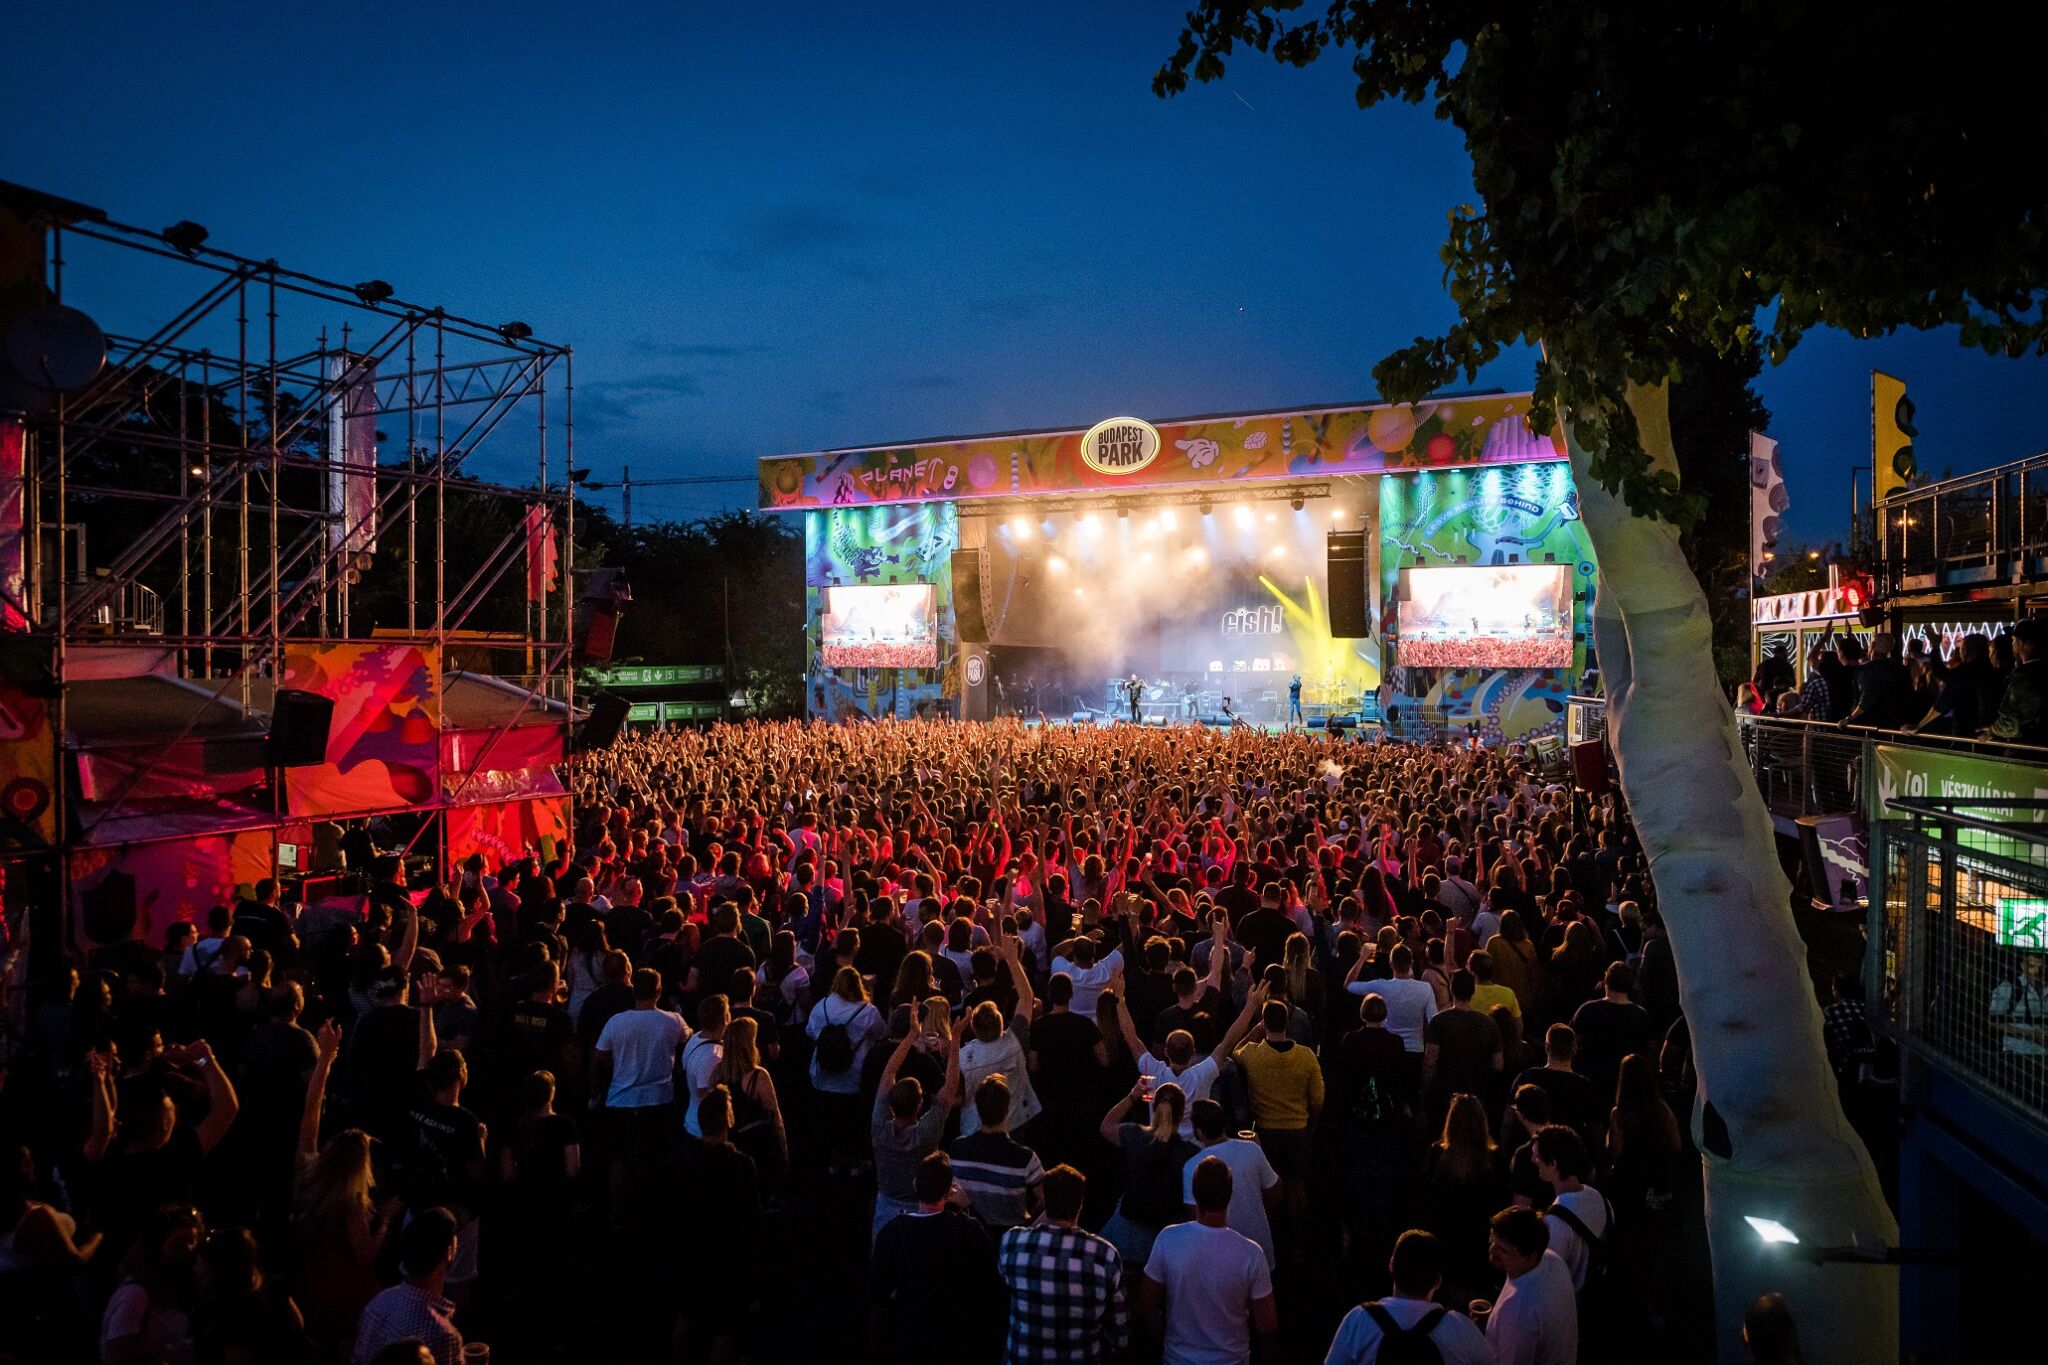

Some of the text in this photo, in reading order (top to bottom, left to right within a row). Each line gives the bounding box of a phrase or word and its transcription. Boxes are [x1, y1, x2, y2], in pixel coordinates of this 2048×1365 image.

[1098, 426, 1143, 444] BUDAPEST
[1098, 442, 1143, 466] PARK
[860, 458, 959, 490] PLANET 8
